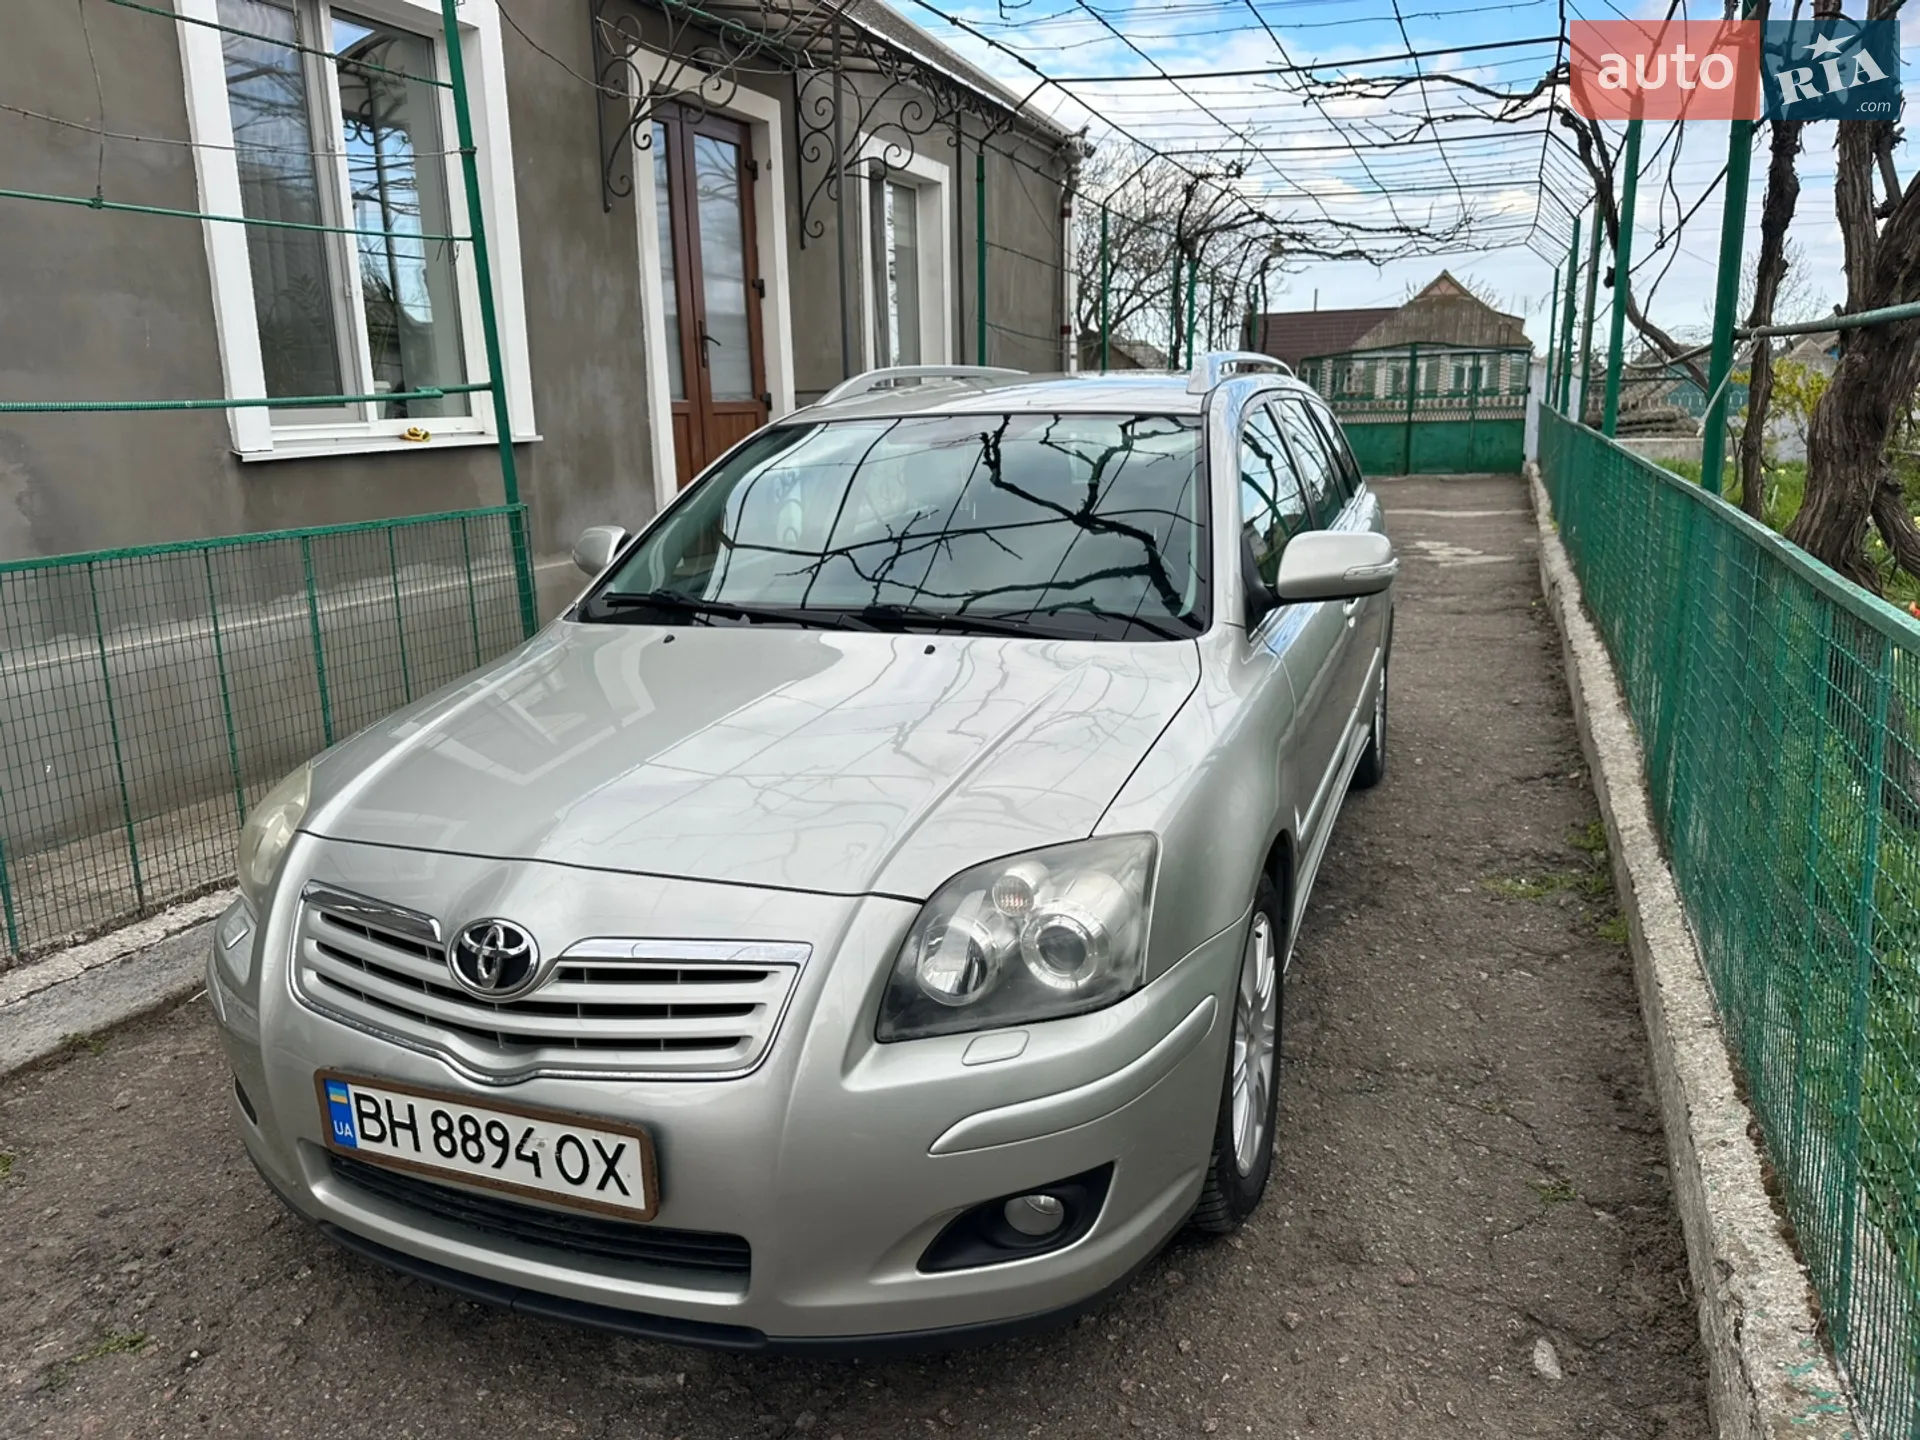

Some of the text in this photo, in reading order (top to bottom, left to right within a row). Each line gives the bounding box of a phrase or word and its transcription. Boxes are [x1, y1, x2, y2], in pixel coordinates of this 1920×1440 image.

[334, 1120, 354, 1138] UA
[354, 1092, 631, 1197] BH 8894 OX
